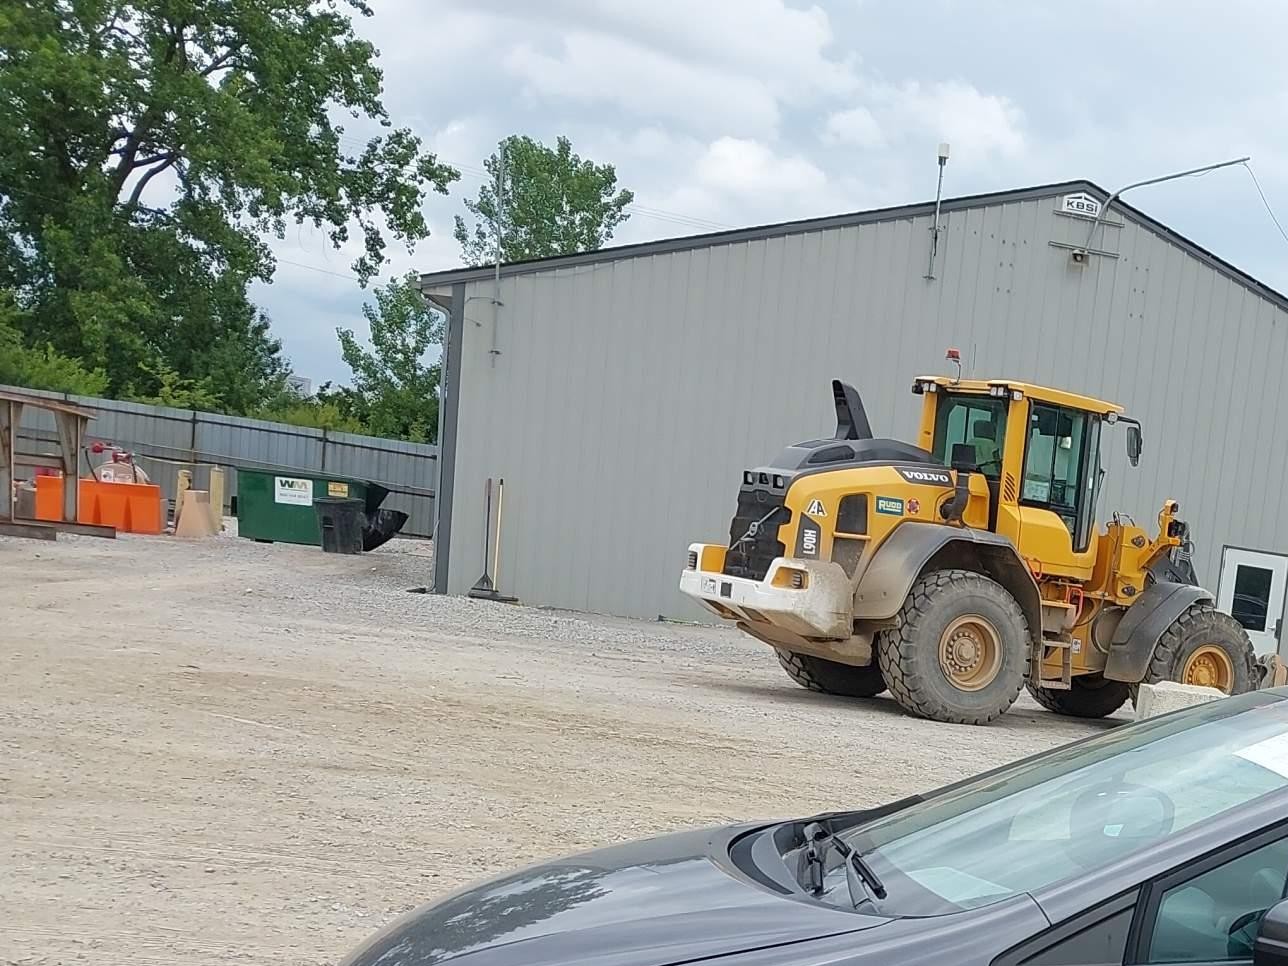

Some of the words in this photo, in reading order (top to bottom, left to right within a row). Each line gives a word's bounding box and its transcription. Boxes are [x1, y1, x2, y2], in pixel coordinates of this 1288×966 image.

[1066, 200, 1098, 213] KBSI
[902, 470, 949, 482] VOLVO
[279, 480, 308, 489] WM
[803, 529, 817, 555] L90H
